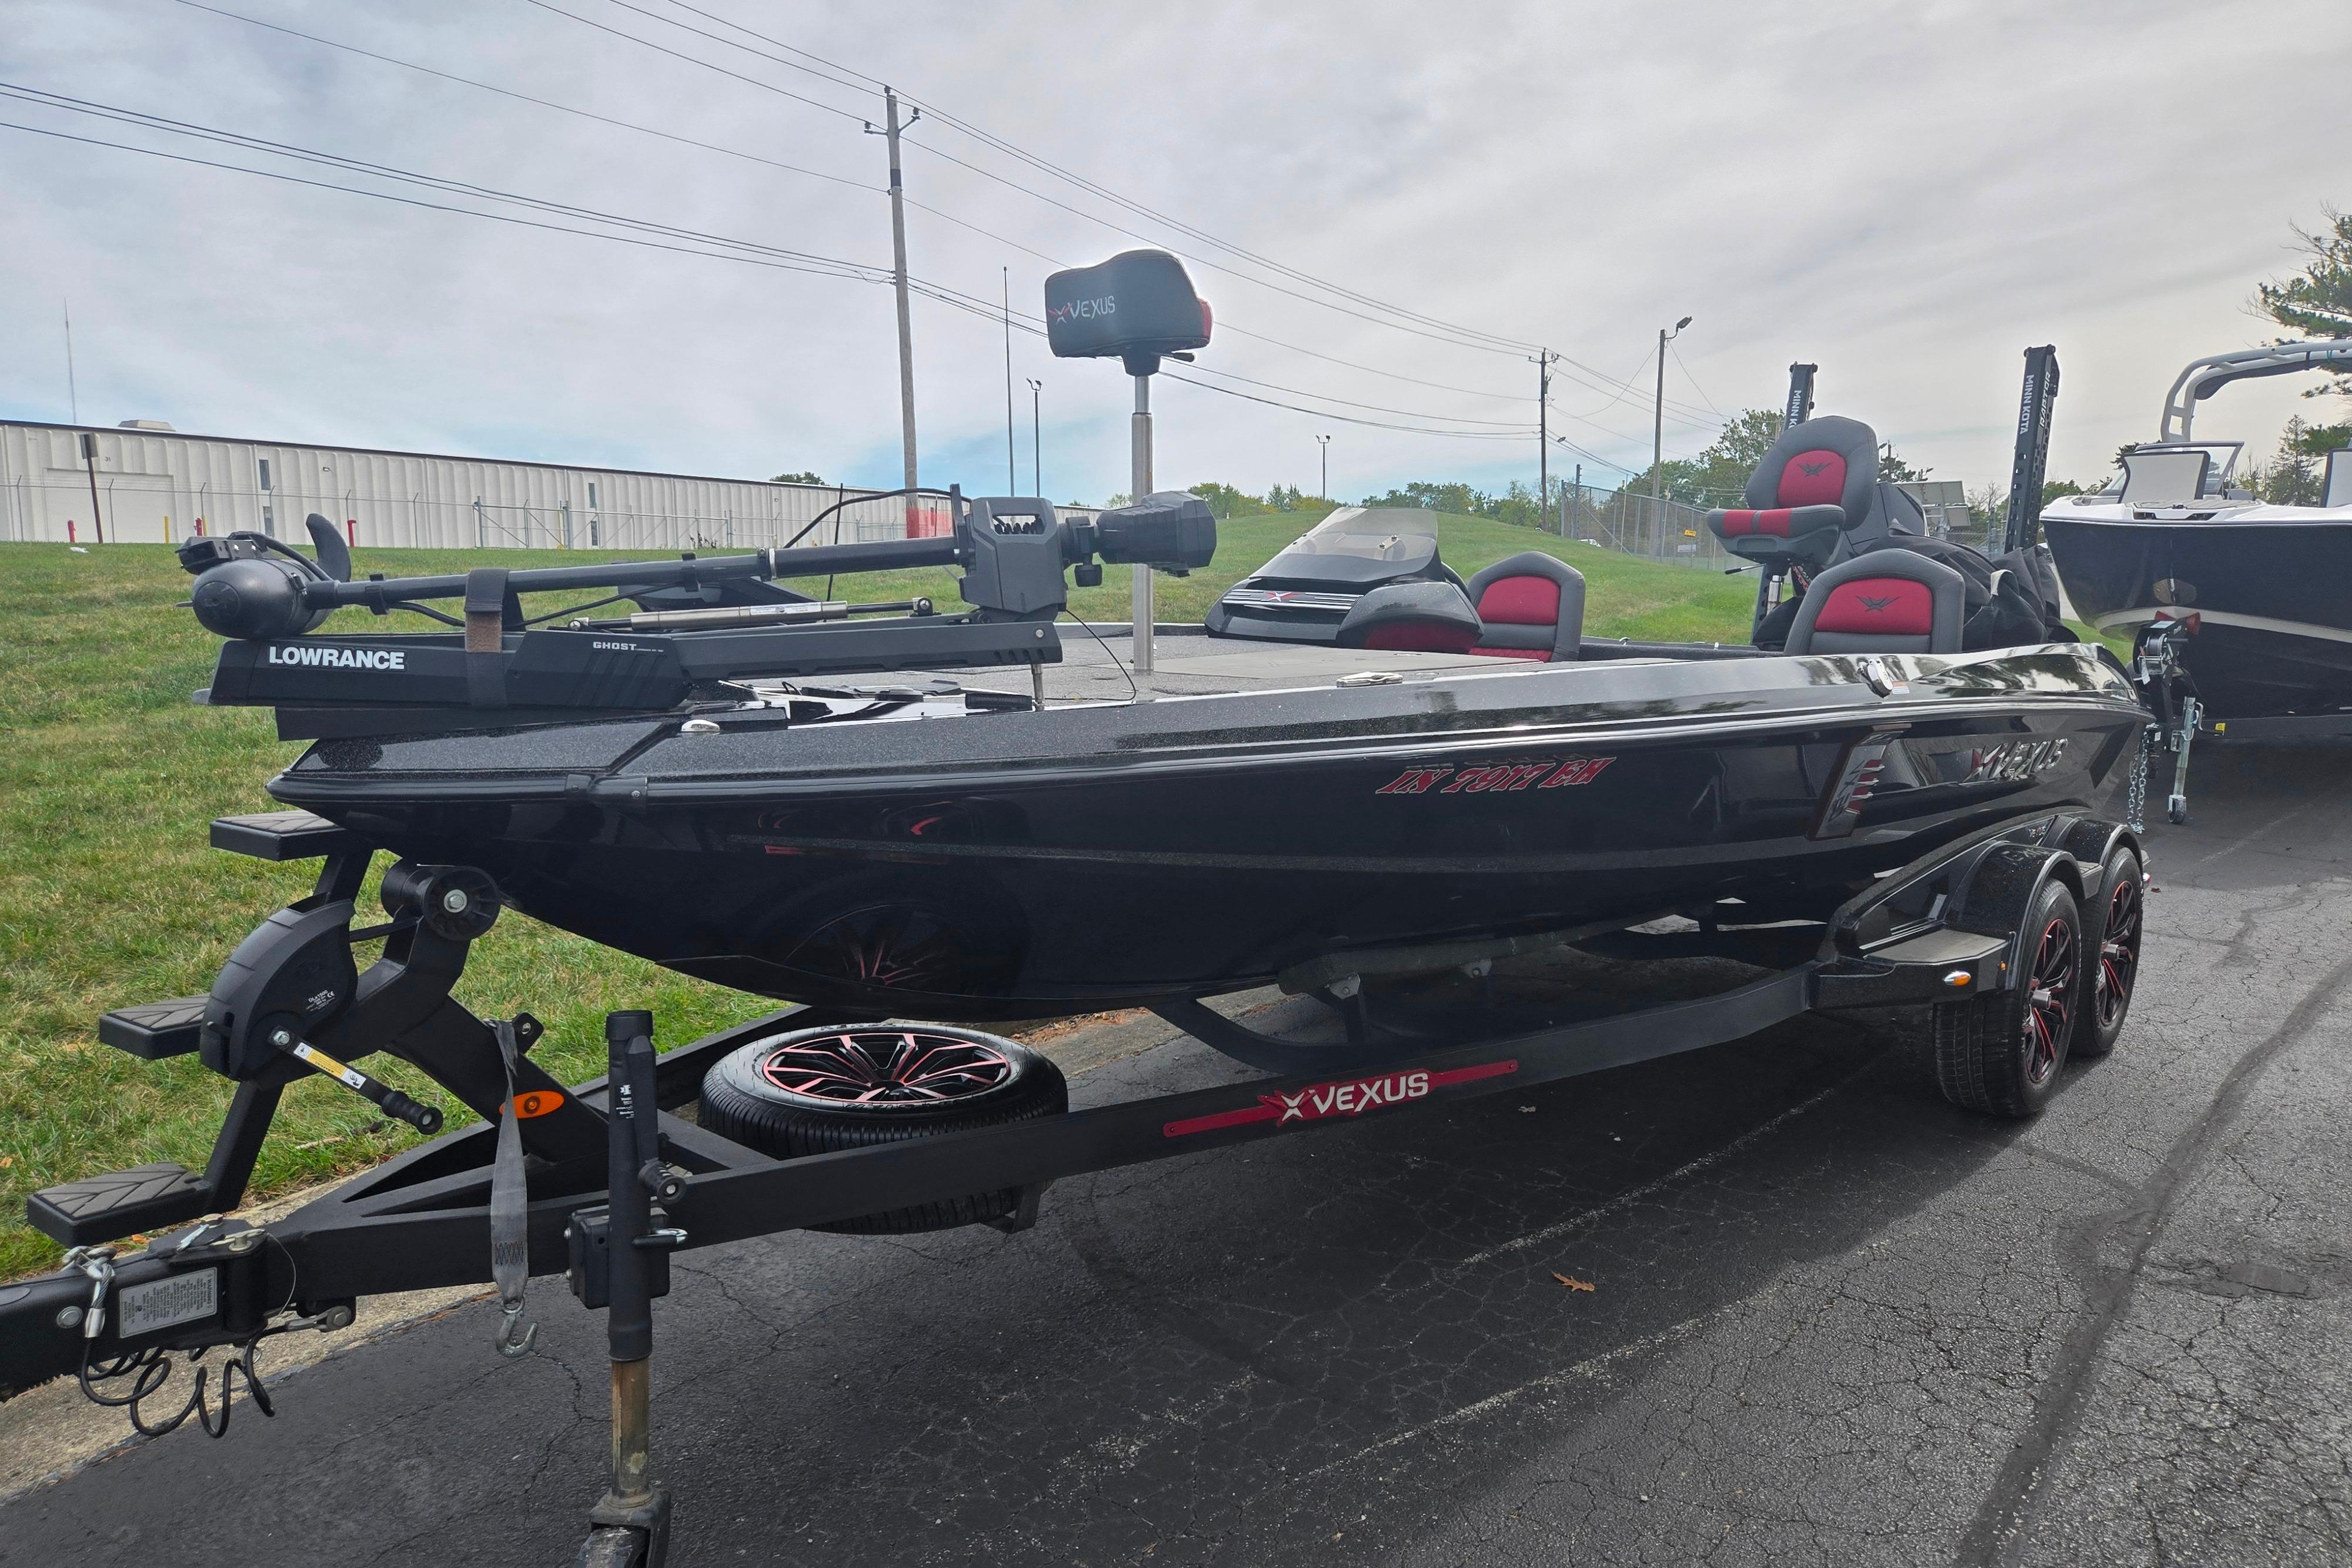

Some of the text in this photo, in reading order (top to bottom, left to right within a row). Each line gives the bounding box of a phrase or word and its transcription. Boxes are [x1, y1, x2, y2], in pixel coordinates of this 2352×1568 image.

[1068, 295, 1115, 320] VEXUS
[1790, 390, 1802, 416] MINN
[2020, 375, 2034, 435] MINN KOTA
[2039, 371, 2051, 427] RAPTOR
[269, 647, 405, 670] LOWRANCE
[593, 641, 637, 651] GHOST
[1375, 768, 1455, 794] IN
[1440, 763, 1556, 792] 7917
[1308, 1072, 1429, 1114] VEXUS
